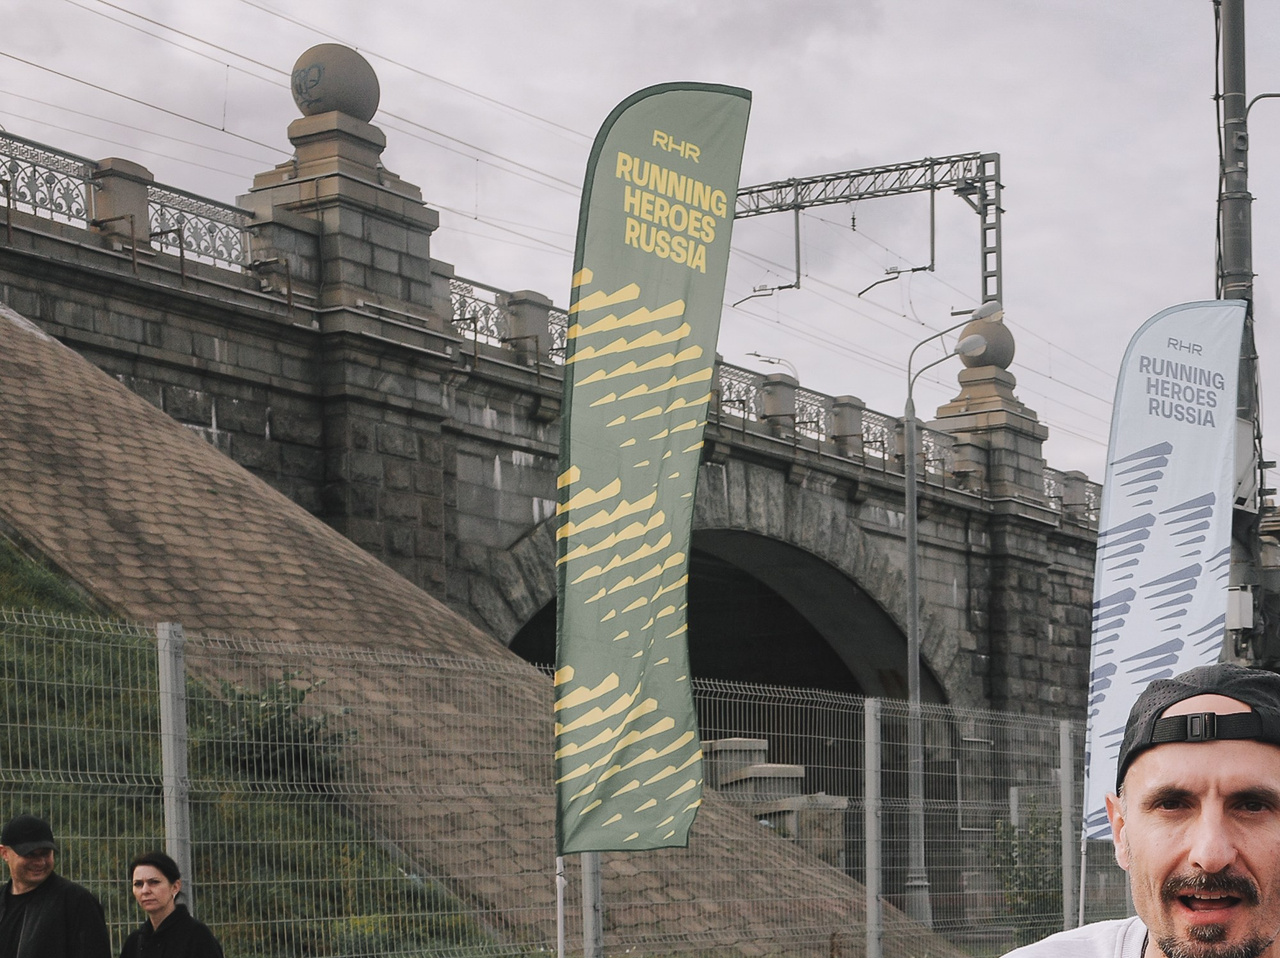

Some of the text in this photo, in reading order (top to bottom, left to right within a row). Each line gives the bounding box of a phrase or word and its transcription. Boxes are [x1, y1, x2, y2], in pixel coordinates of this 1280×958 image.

[652, 129, 701, 164] RHR
[615, 151, 728, 219] RUNNING
[624, 185, 716, 244] HEROES
[624, 217, 706, 274] RUSSIA
[1167, 337, 1203, 356] RHR
[1139, 355, 1225, 391] RUNNING
[1146, 376, 1217, 408] HEROES
[1148, 397, 1216, 428] RUSSIA
